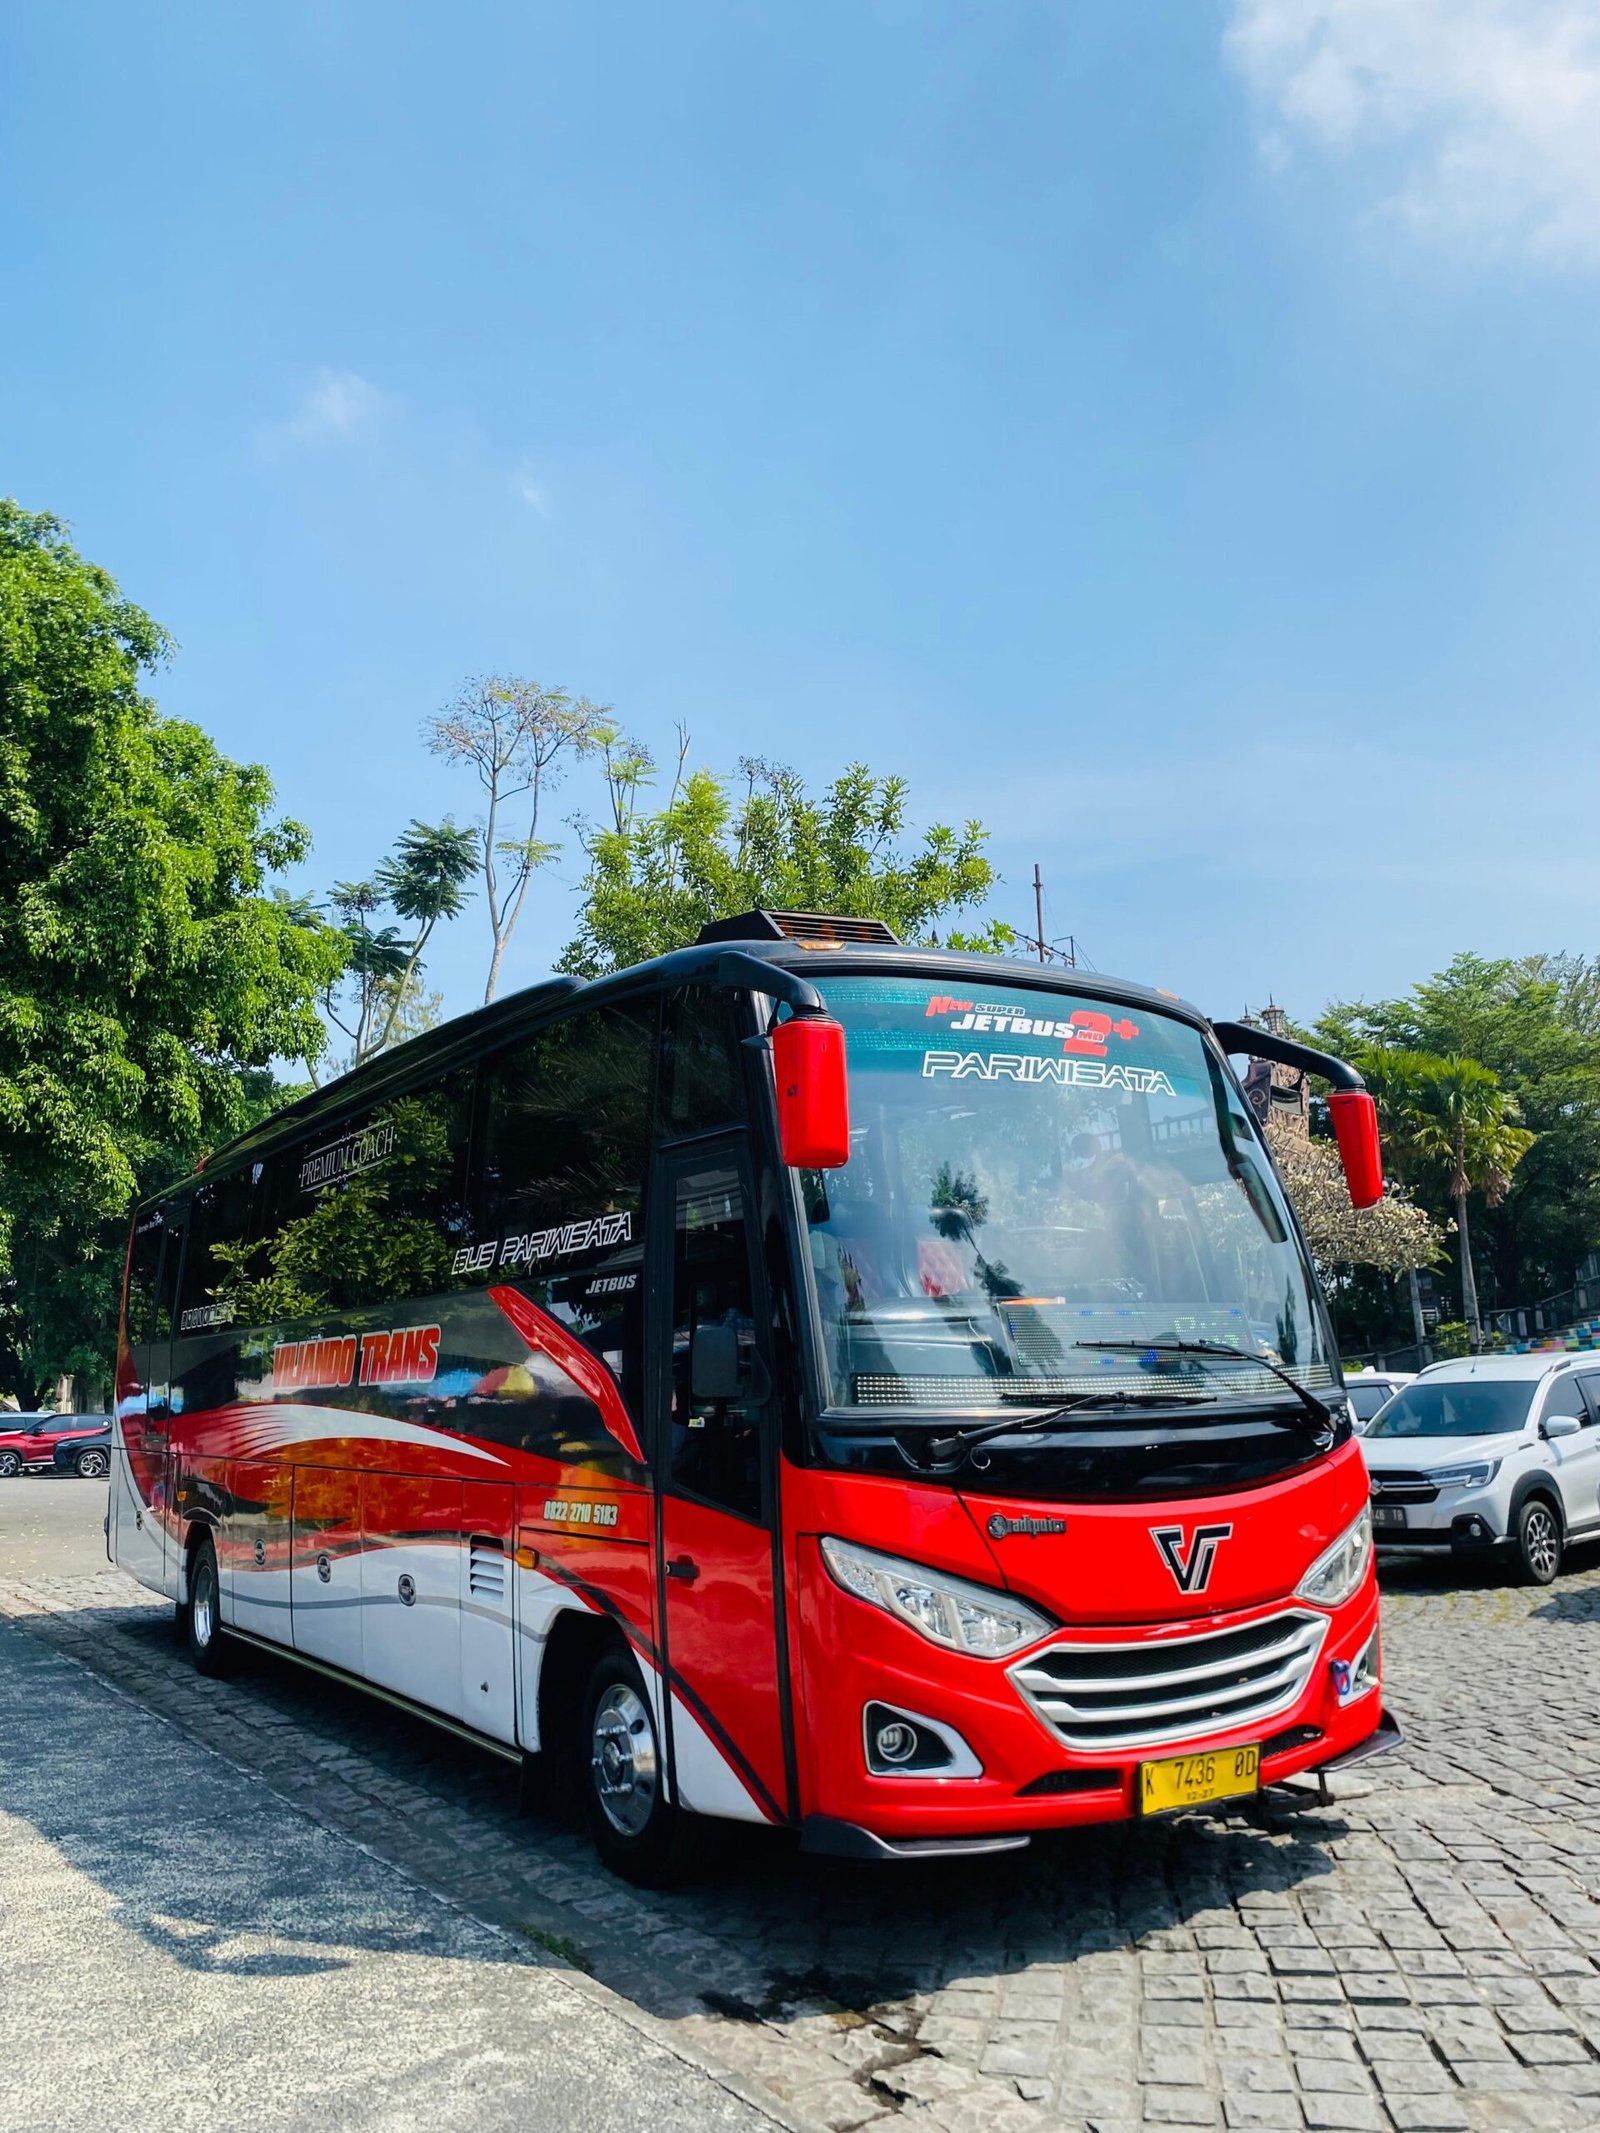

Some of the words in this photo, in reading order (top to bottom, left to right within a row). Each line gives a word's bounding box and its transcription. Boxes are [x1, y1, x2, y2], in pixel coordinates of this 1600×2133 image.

[975, 1003, 1026, 1016] SUPER
[950, 1014, 1074, 1040] JETBUS
[1076, 1029, 1105, 1043] MD
[922, 1050, 1177, 1096] PARIWISATA
[300, 1144, 350, 1187] PREMIUM
[351, 1126, 395, 1168] COACH
[451, 1241, 498, 1275] BUS
[499, 1211, 632, 1266] PARIWISATA
[585, 1274, 637, 1294] JETBUS
[358, 1323, 441, 1387] TRANS
[543, 1500, 568, 1521] 0822
[569, 1502, 592, 1523] 2710
[1145, 1766, 1155, 1797] K
[1174, 1756, 1216, 1790] 7436
